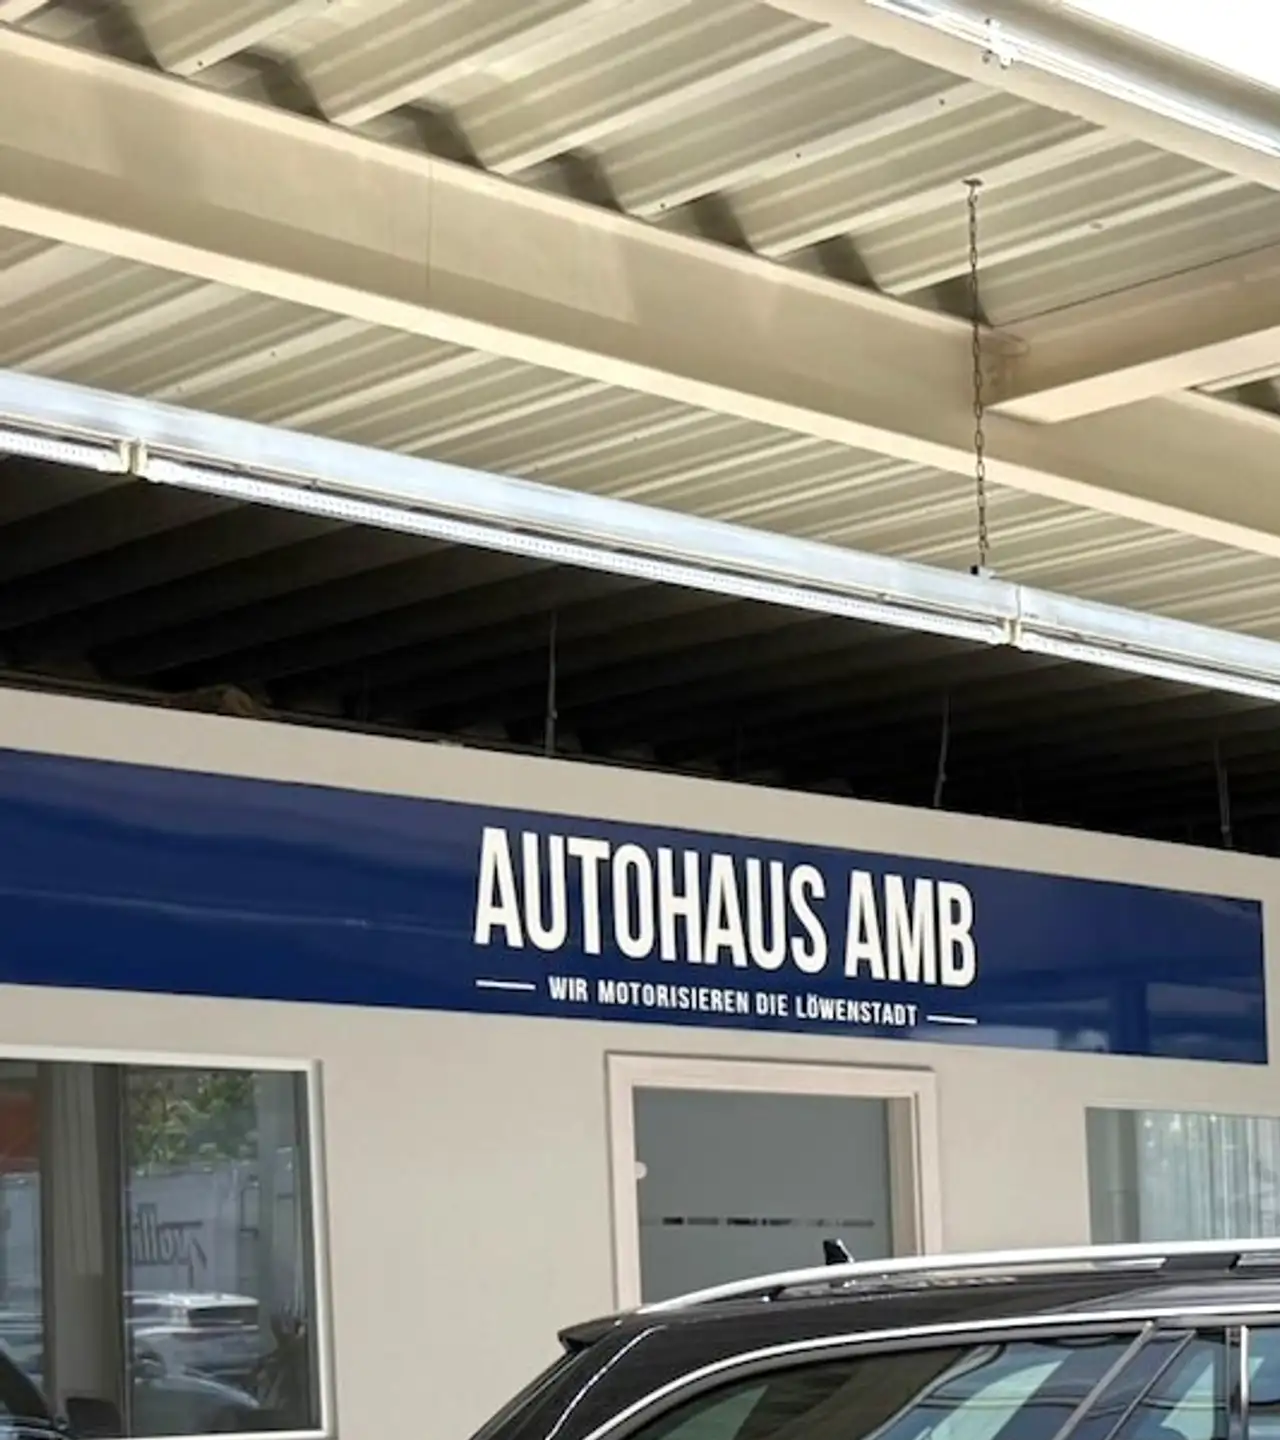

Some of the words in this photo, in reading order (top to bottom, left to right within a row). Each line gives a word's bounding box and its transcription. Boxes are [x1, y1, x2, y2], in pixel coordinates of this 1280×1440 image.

[474, 826, 828, 973] AUTOHAUS
[844, 869, 976, 987] AMB
[548, 976, 589, 1002] WIR
[598, 979, 750, 1014] MOTORISIEREN
[755, 992, 789, 1017] DIE
[795, 993, 917, 1027] LÖWENSTADT
